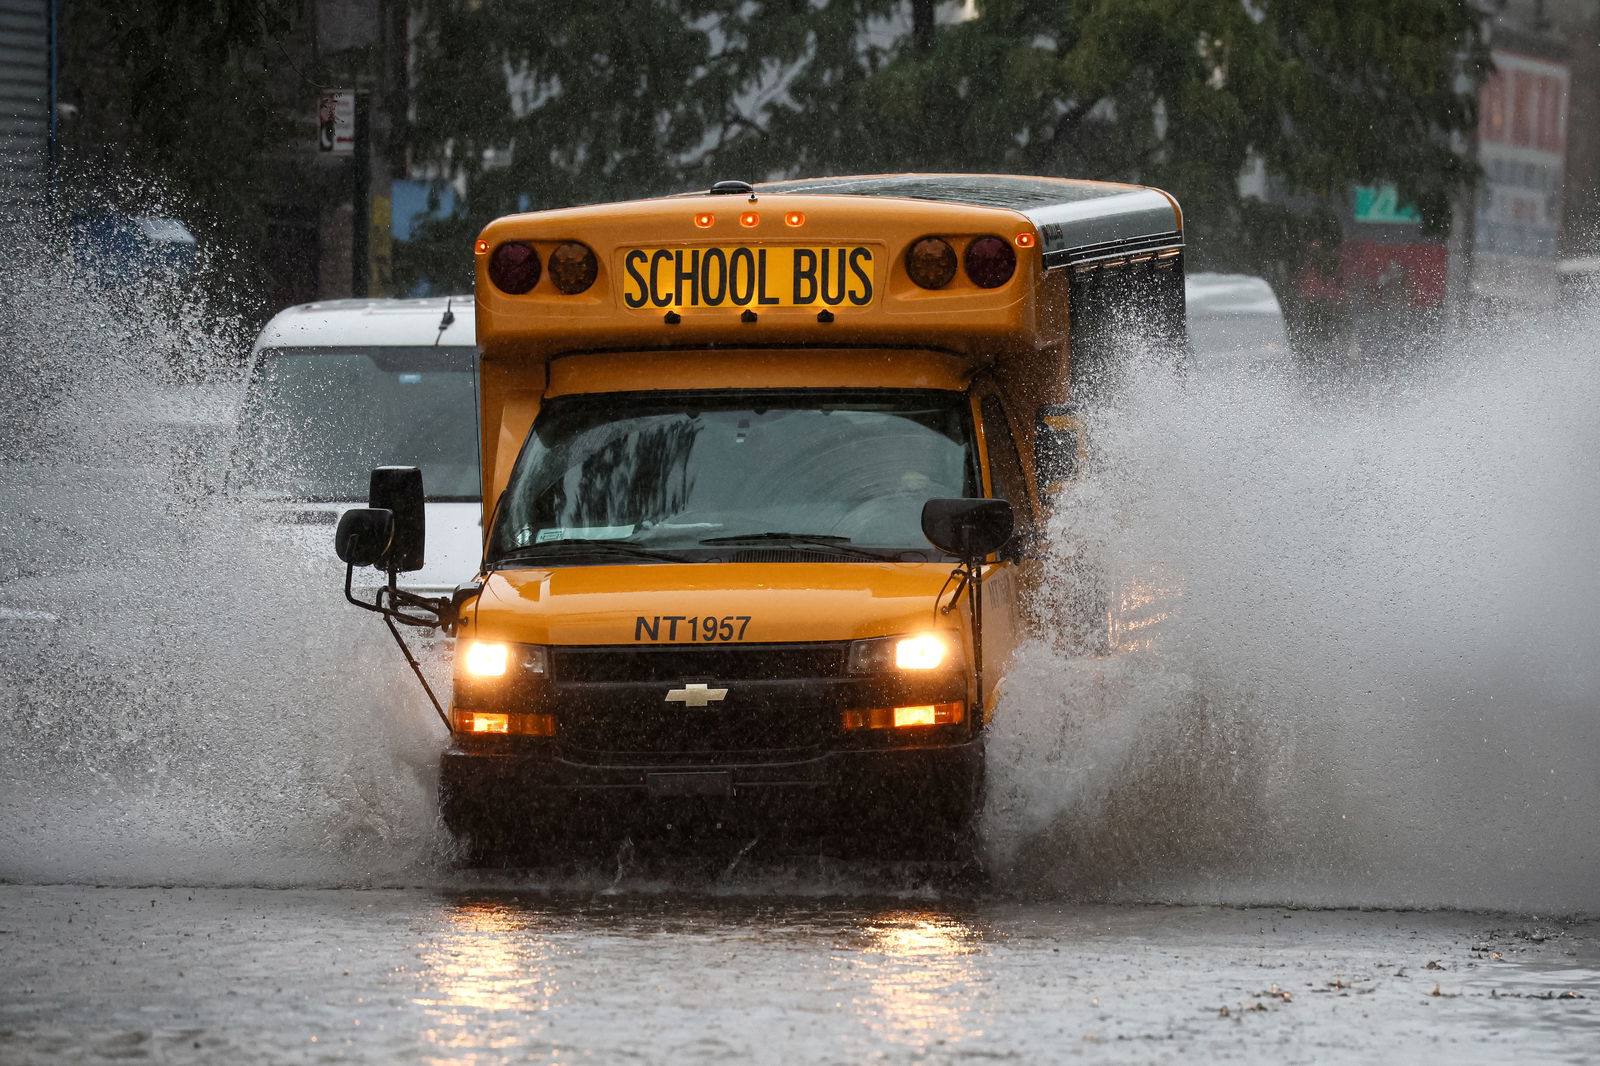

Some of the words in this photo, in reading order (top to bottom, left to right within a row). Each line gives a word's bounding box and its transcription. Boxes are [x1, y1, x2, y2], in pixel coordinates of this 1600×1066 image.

[624, 247, 780, 308] SCHOOL
[793, 247, 873, 306] BUS
[635, 616, 752, 641] NT1957
